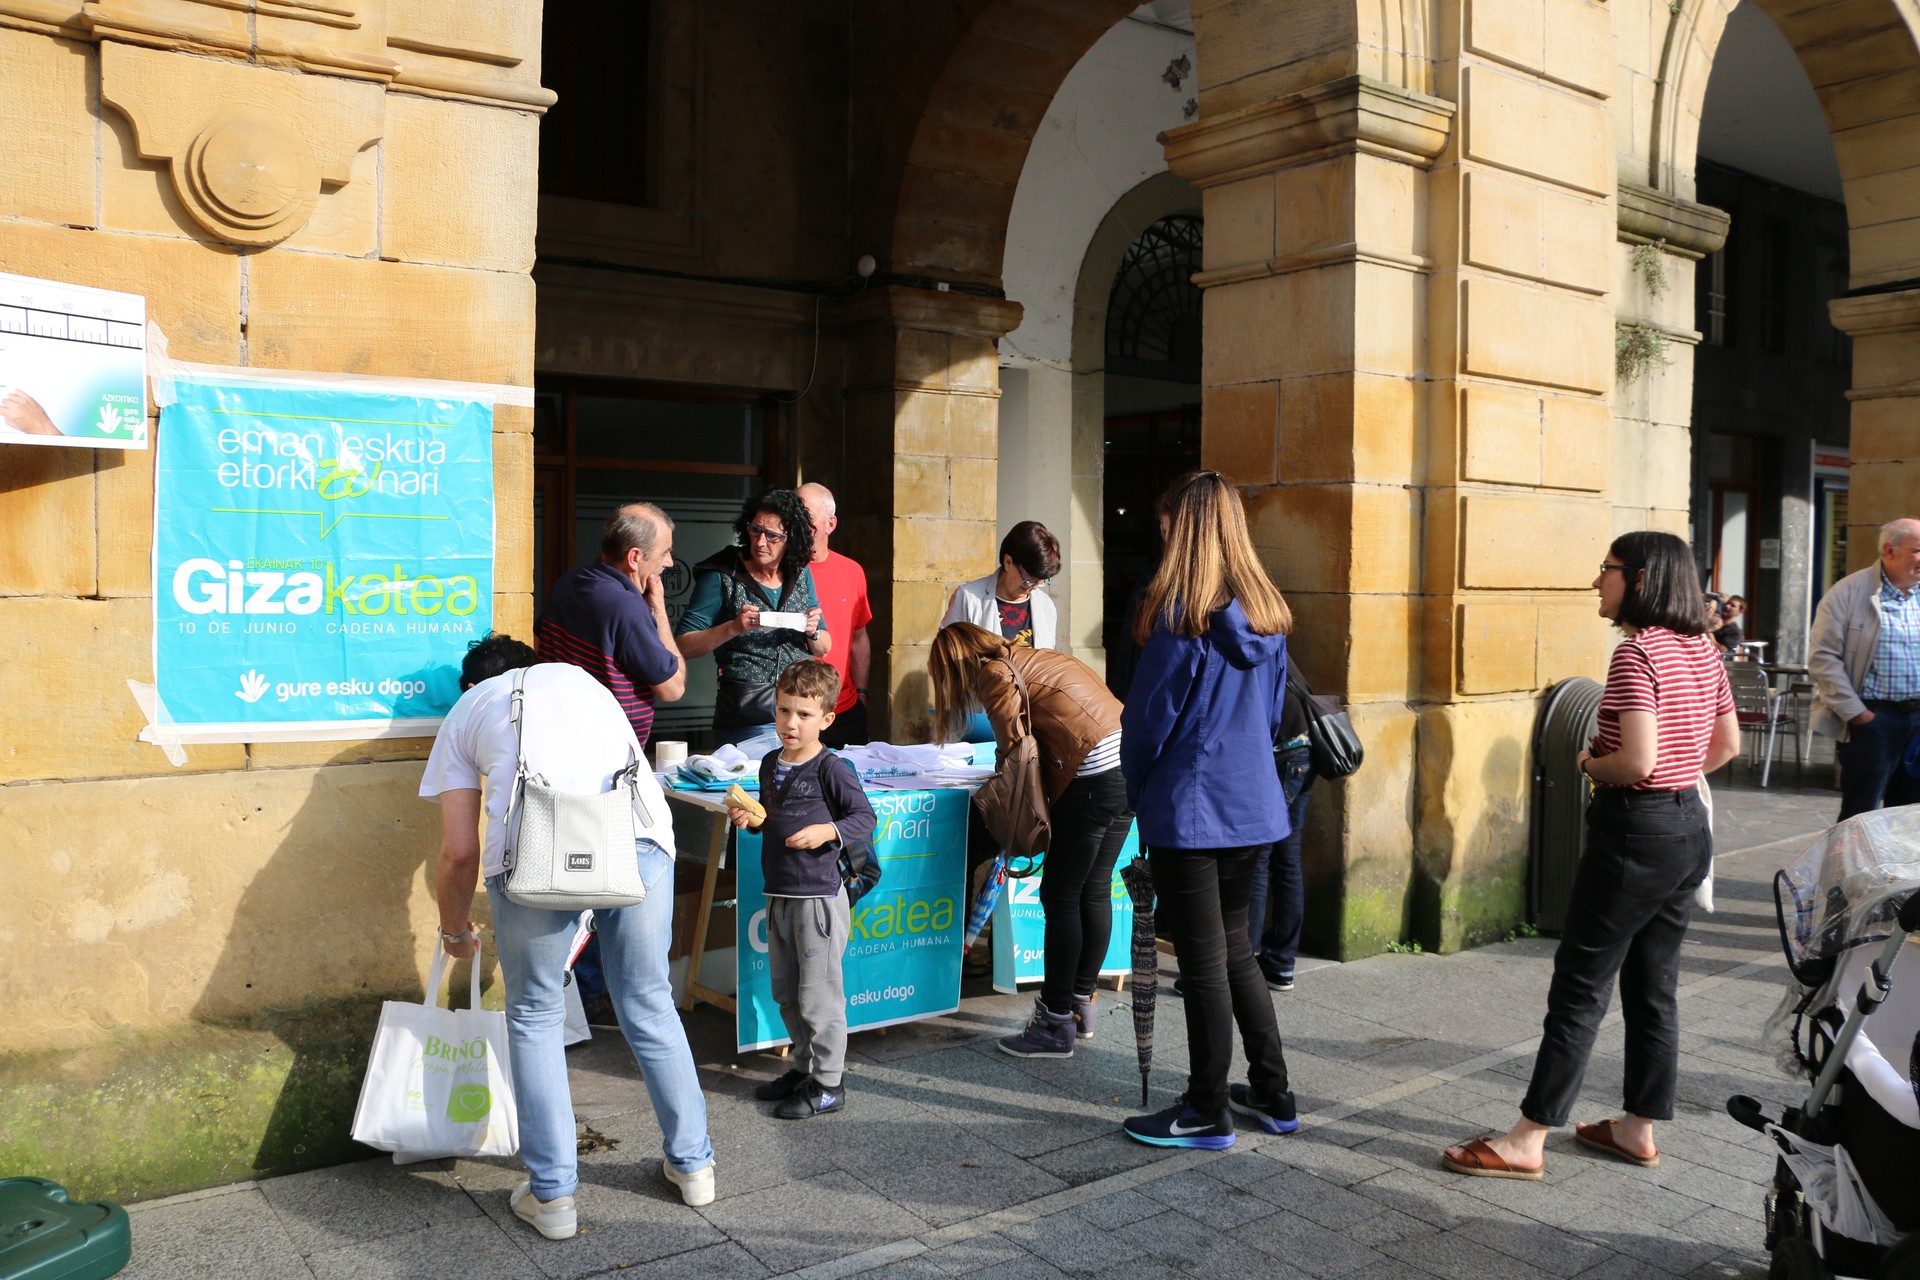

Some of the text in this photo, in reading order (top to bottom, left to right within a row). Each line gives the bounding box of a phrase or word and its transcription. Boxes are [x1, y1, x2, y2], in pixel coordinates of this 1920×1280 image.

[102, 394, 139, 404] AZKOITIKO
[217, 428, 446, 464] eman eskua
[247, 557, 323, 570] EKAINAK 10
[178, 622, 475, 634] 10 DE JUNIO CADENA HUMANA
[276, 677, 426, 703] gure esku dago
[571, 857, 590, 865] LOIS
[752, 934, 950, 971] 10 CADENA HUMANA
[1023, 948, 1045, 963] gur
[850, 984, 915, 1006] esku dago
